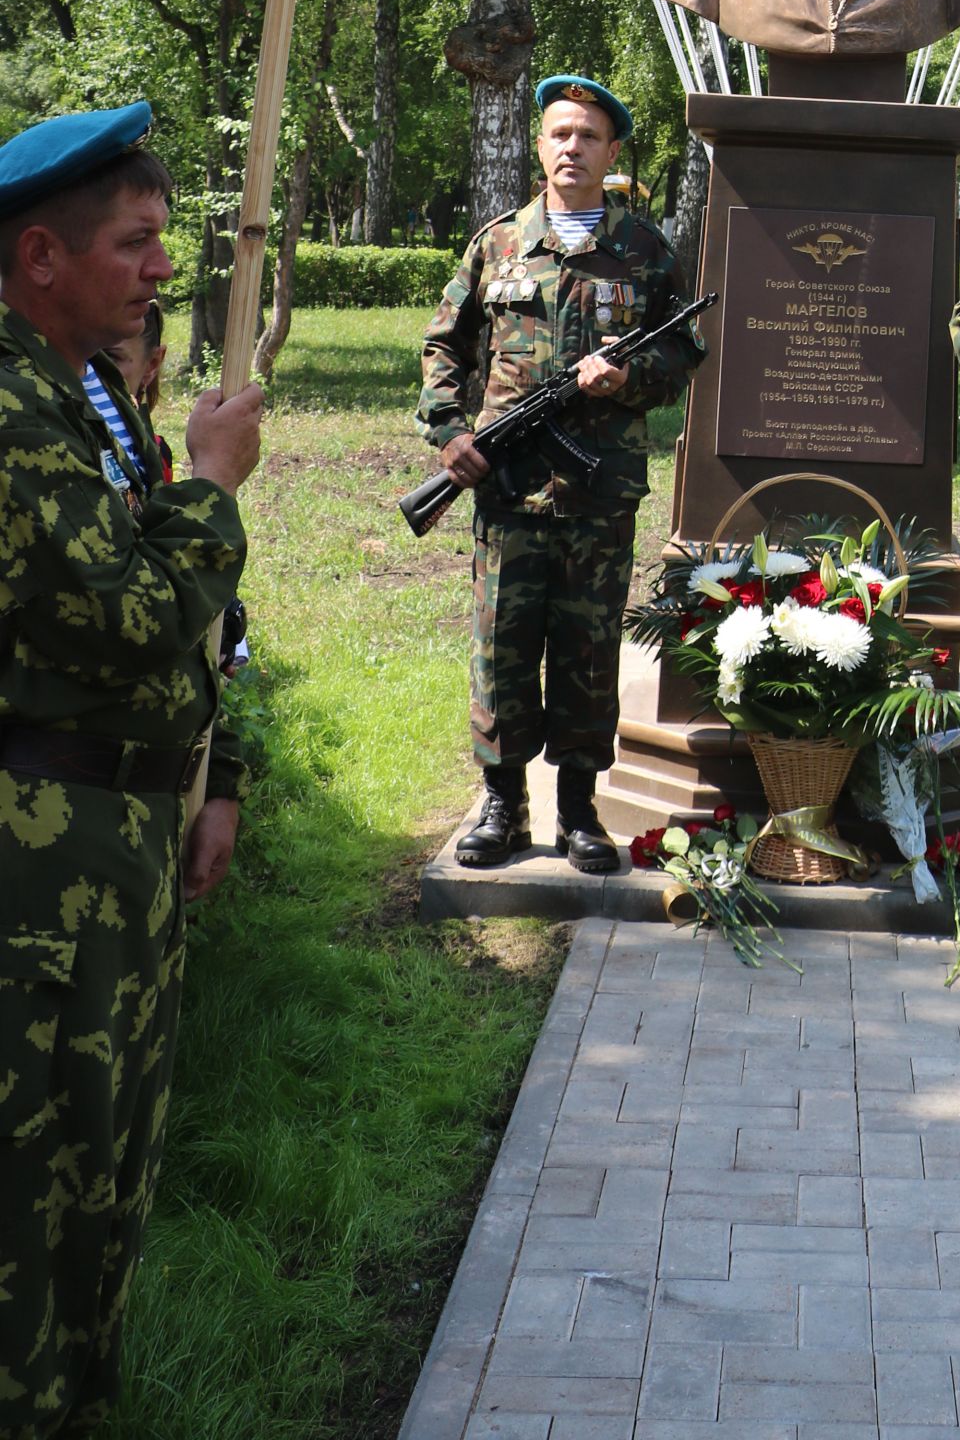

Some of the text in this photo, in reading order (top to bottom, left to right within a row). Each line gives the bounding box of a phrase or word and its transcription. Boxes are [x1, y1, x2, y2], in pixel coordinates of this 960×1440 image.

[765, 279, 891, 294] Герой Советского Союза
[808, 293, 847, 304] (1944 г.)
[786, 303, 867, 318] МАРГЕЛОВ
[747, 317, 905, 336] Василий Филиппович
[850, 338, 861, 347] гг.
[785, 347, 827, 358] Генерал
[788, 359, 860, 370] командующий
[765, 369, 882, 382] Воздушно-десантными
[783, 382, 863, 392] войсками СССР
[871, 397, 884, 408] гг.)
[766, 420, 788, 428] Бюст
[742, 429, 773, 438] Проект
